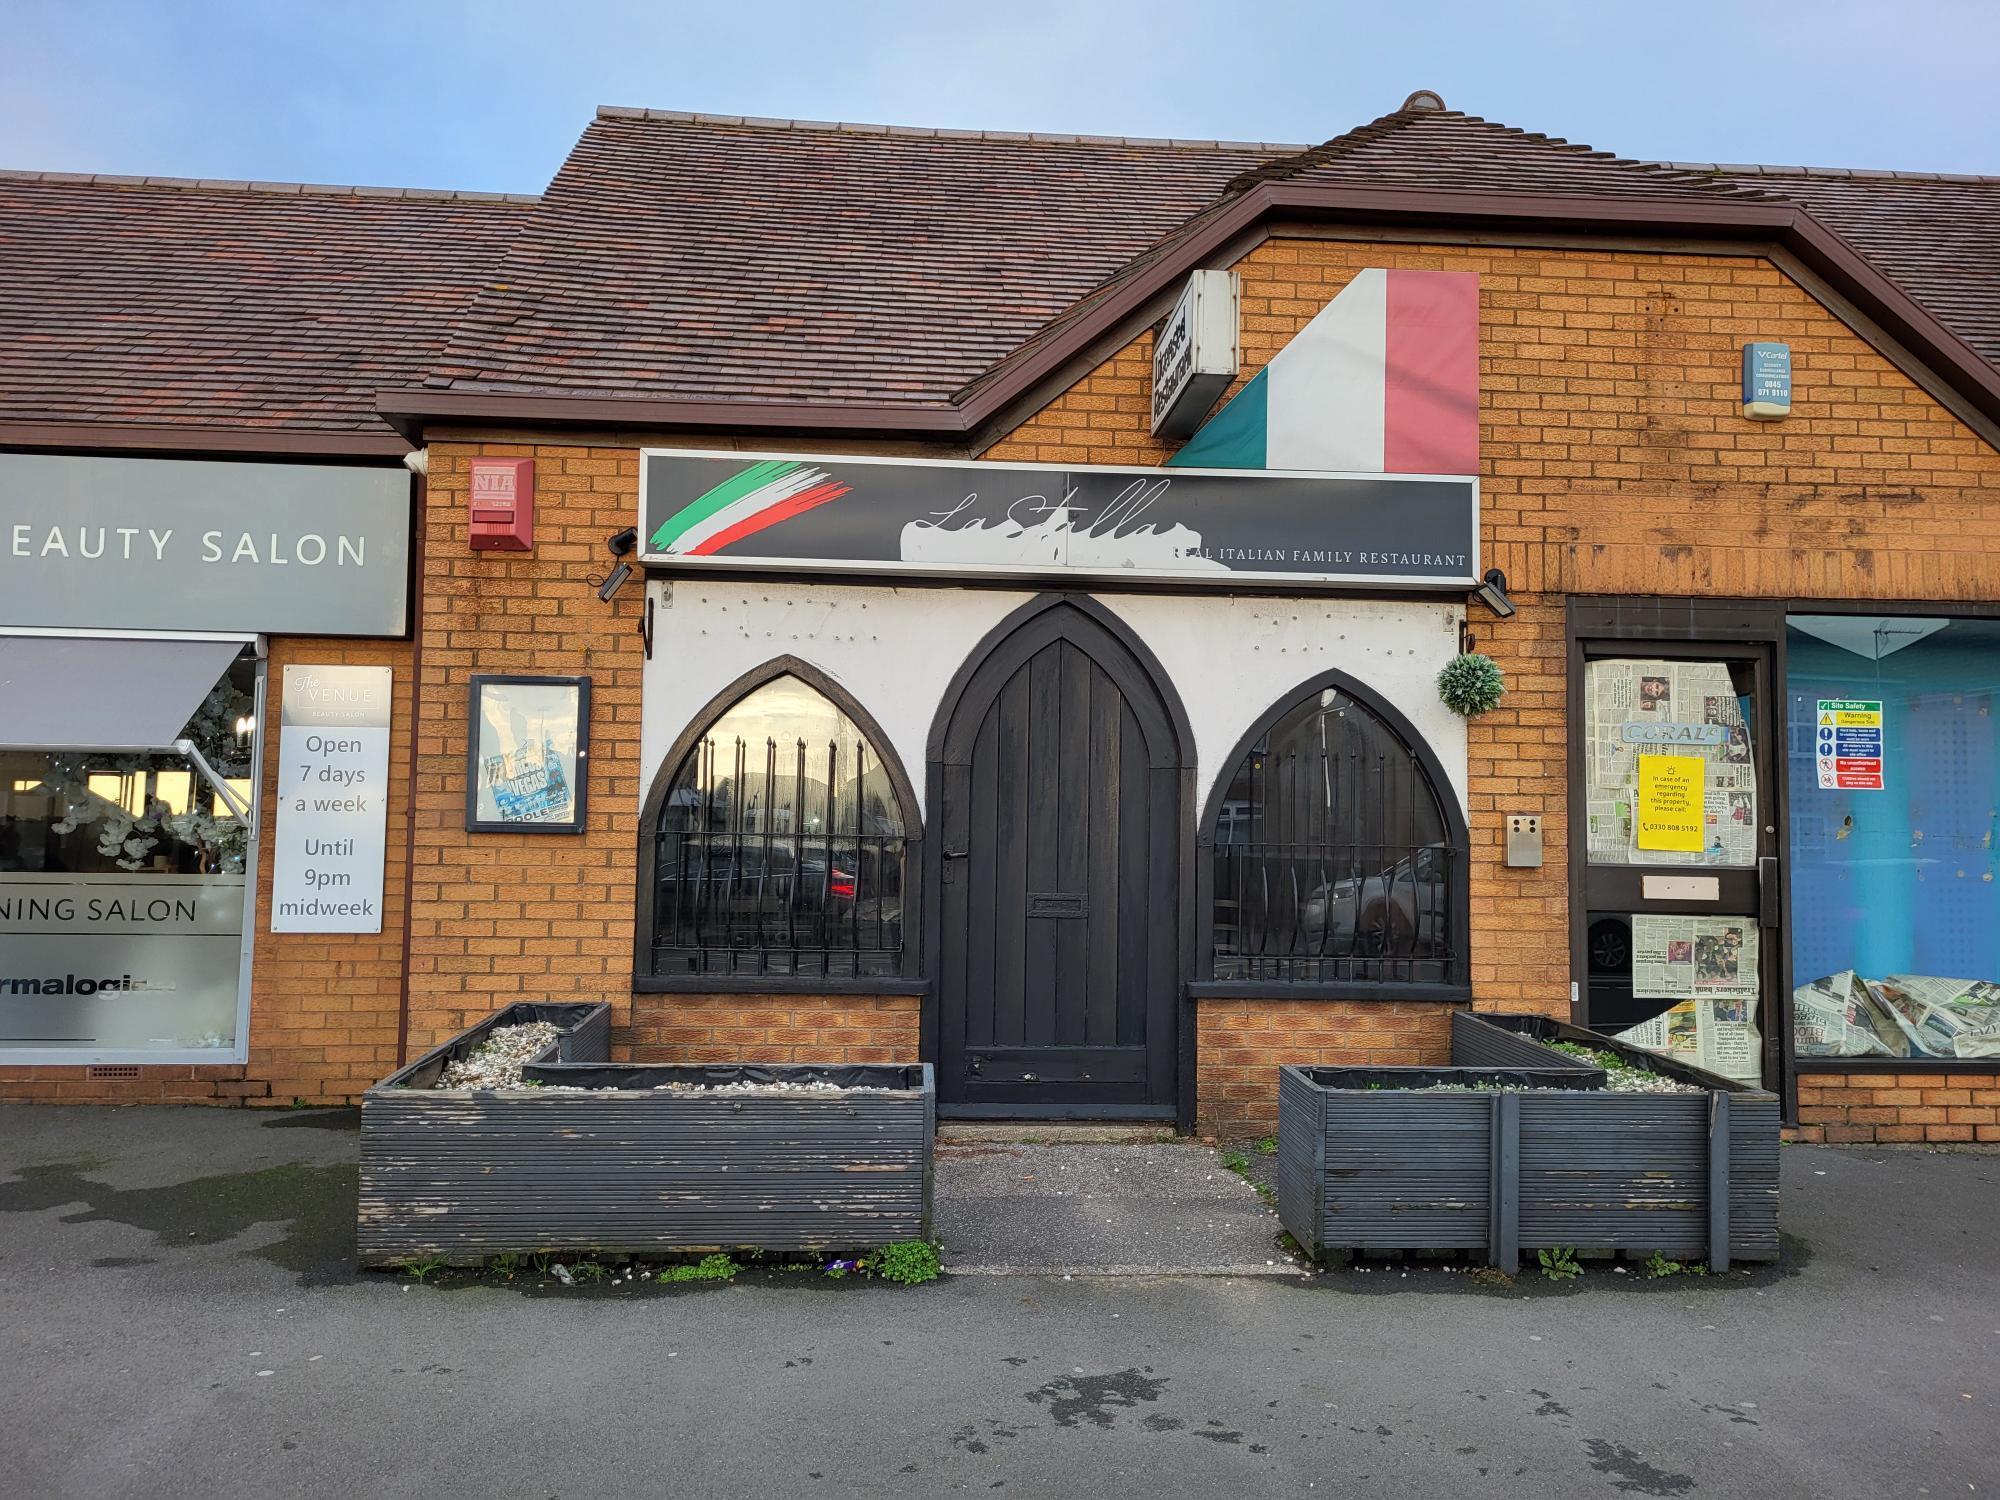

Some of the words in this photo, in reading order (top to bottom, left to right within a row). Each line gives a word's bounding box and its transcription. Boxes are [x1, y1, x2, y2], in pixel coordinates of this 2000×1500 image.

[474, 475, 514, 492] NIA
[12, 525, 173, 561] EAUTY
[201, 531, 365, 567] SALON
[1220, 548, 1286, 562] ITALIAN
[1293, 550, 1353, 564] FAMILY
[1360, 552, 1466, 567] RESTAURANT
[294, 674, 321, 693] The
[308, 688, 374, 703] VENUE
[342, 711, 365, 719] SALON
[1845, 702, 1866, 710] Safety
[1626, 725, 1705, 741] CORAL
[306, 735, 362, 757] Open
[300, 765, 311, 781] 7
[319, 765, 365, 787] days
[508, 771, 548, 796] VEGAS
[295, 799, 306, 812] a
[314, 795, 367, 812] week
[305, 838, 353, 856] Until
[304, 868, 350, 890] 9pm
[0, 898, 75, 921] NING
[87, 898, 196, 922] SALON
[280, 898, 374, 916] midweek
[0, 974, 148, 1000] rmalogi
[1695, 986, 1712, 994] bank
